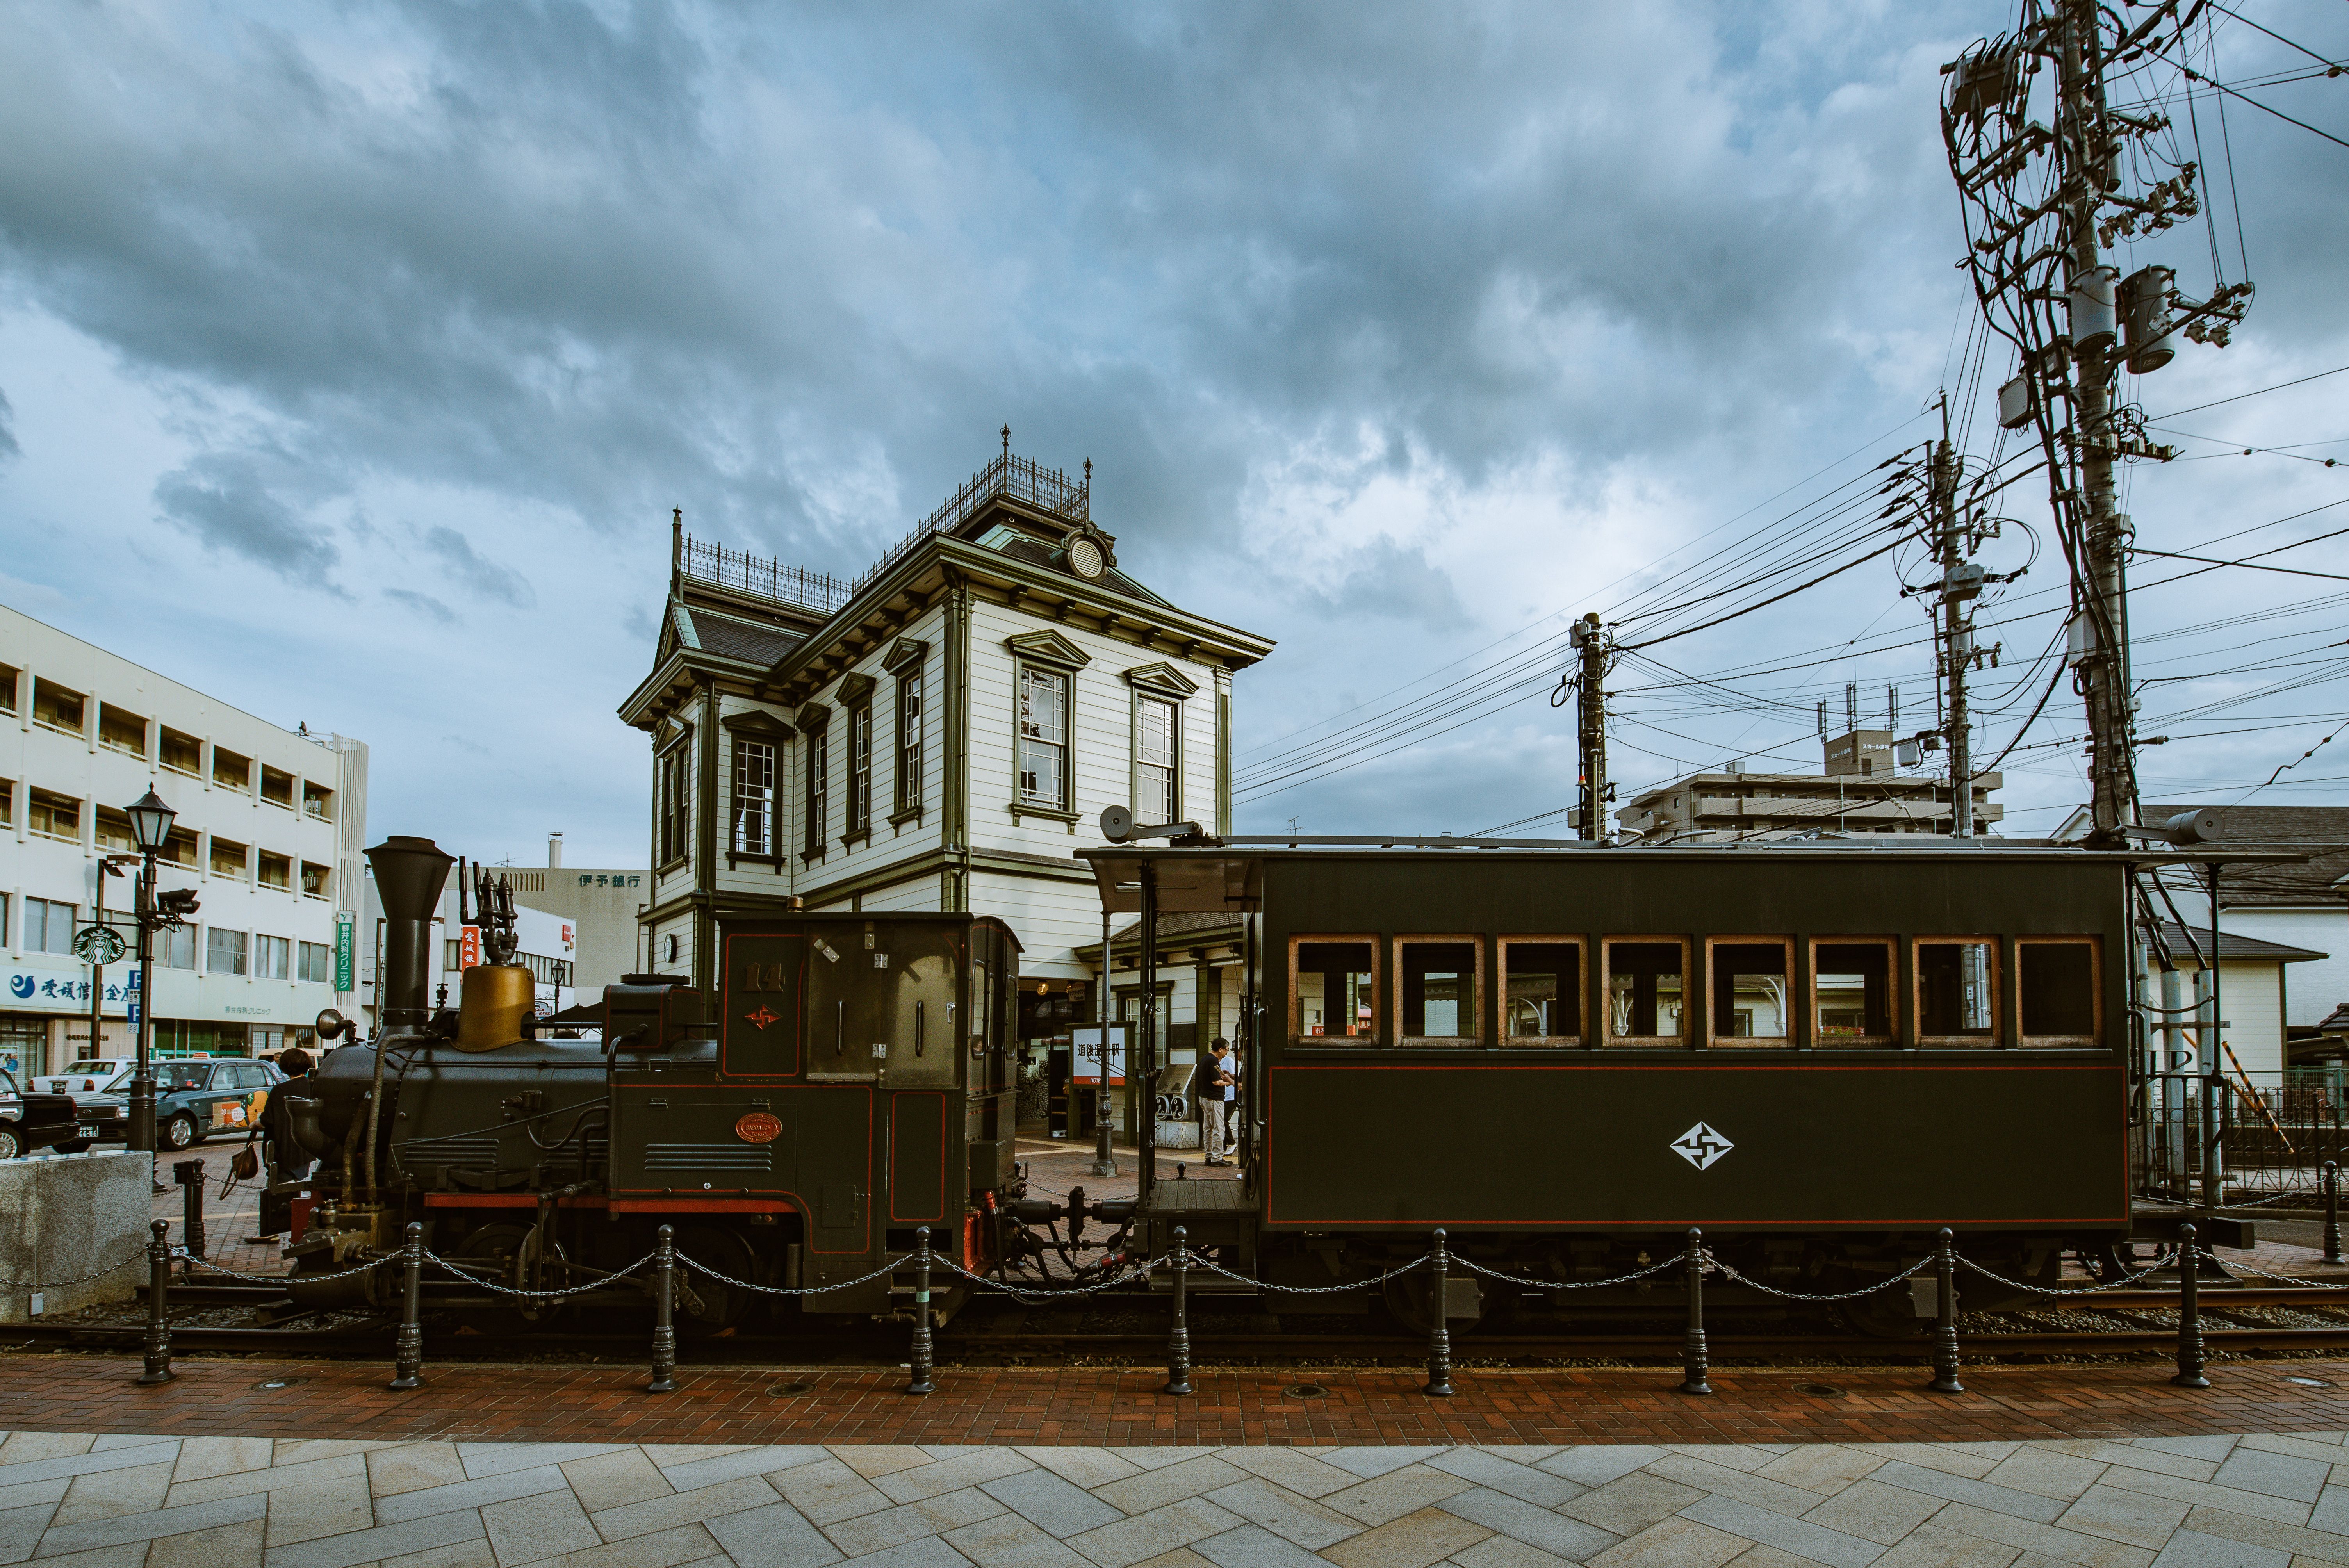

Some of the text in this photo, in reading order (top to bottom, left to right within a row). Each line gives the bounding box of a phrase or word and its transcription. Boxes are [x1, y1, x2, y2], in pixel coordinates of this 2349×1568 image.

[579, 874, 640, 887] 伊予銀行
[340, 924, 349, 989] 柳井内科クリニック
[464, 932, 475, 967] 愛媛銀
[41, 979, 128, 1001] 愛媛信金
[743, 962, 786, 992] 14
[1078, 1043, 1119, 1056] 道後温駅
